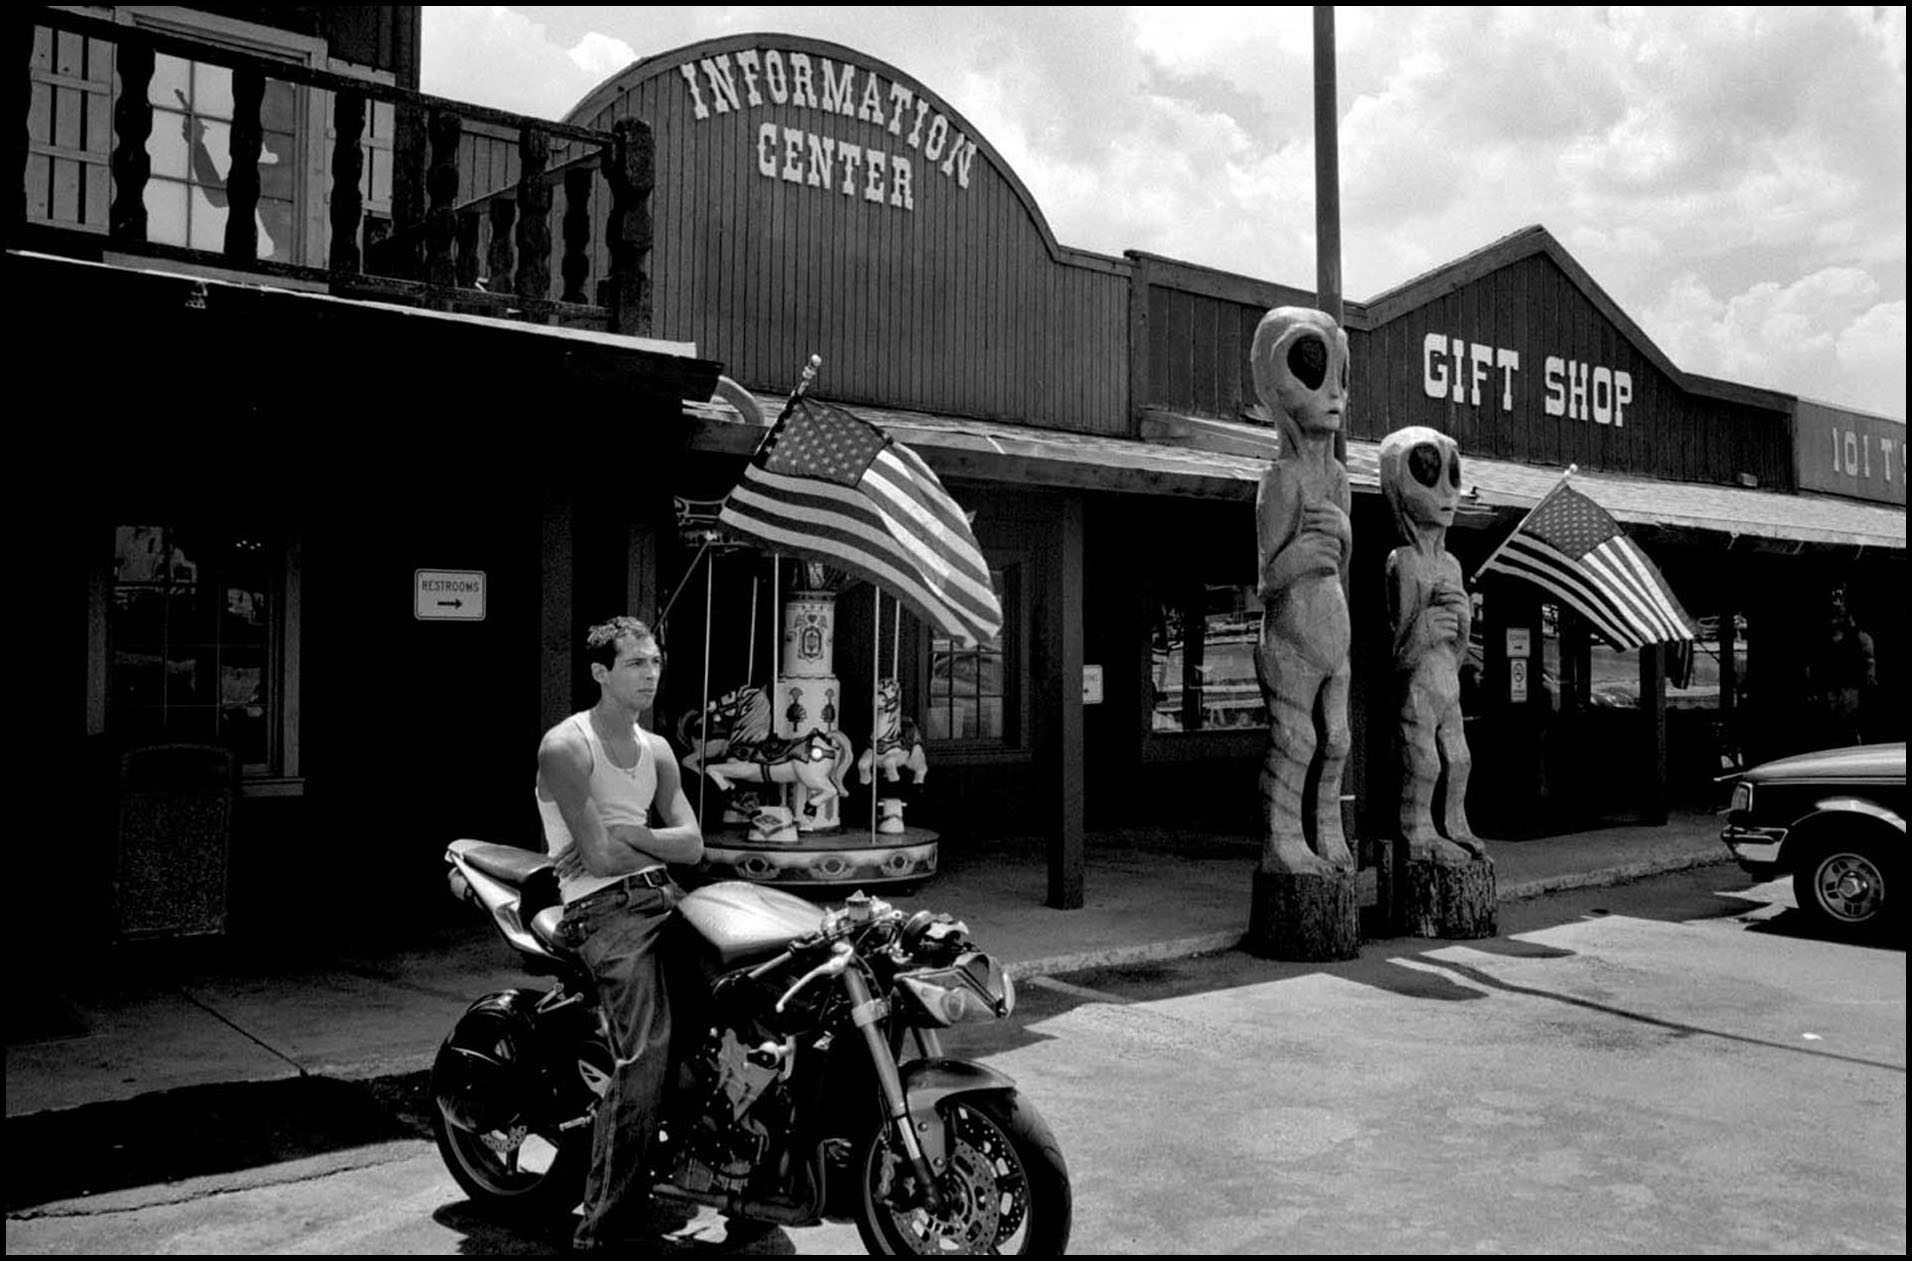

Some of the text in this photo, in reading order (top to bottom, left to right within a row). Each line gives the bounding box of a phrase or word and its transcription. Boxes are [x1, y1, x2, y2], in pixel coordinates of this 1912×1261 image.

[680, 49, 977, 189] INFORMATION
[757, 122, 913, 210] CENTER
[1424, 333, 1632, 427] GIFT SHOP
[422, 580, 480, 592] RESTROOMS
